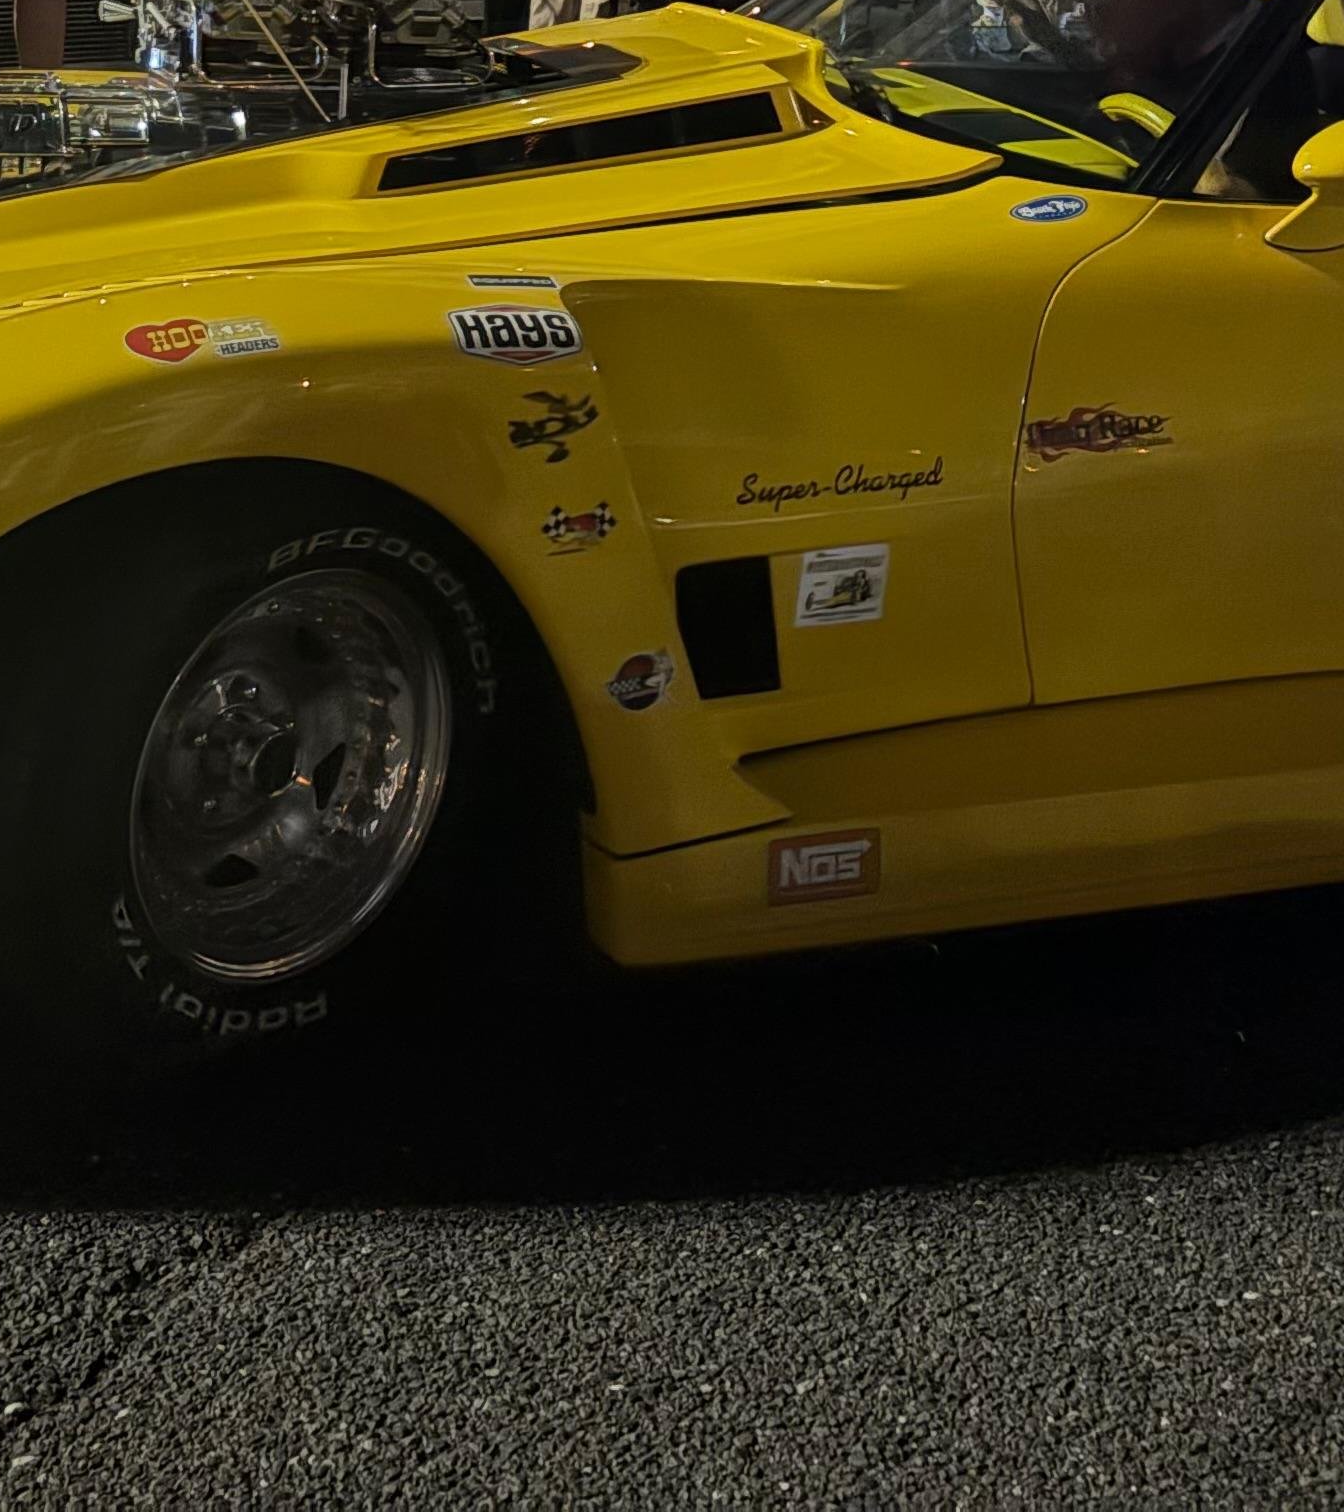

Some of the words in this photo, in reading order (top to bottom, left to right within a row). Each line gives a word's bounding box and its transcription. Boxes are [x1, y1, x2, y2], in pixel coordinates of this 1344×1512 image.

[221, 338, 280, 356] HEADERS
[736, 456, 945, 513] Super-Charged
[780, 840, 863, 886] NOS
[159, 981, 330, 1036] Radial
